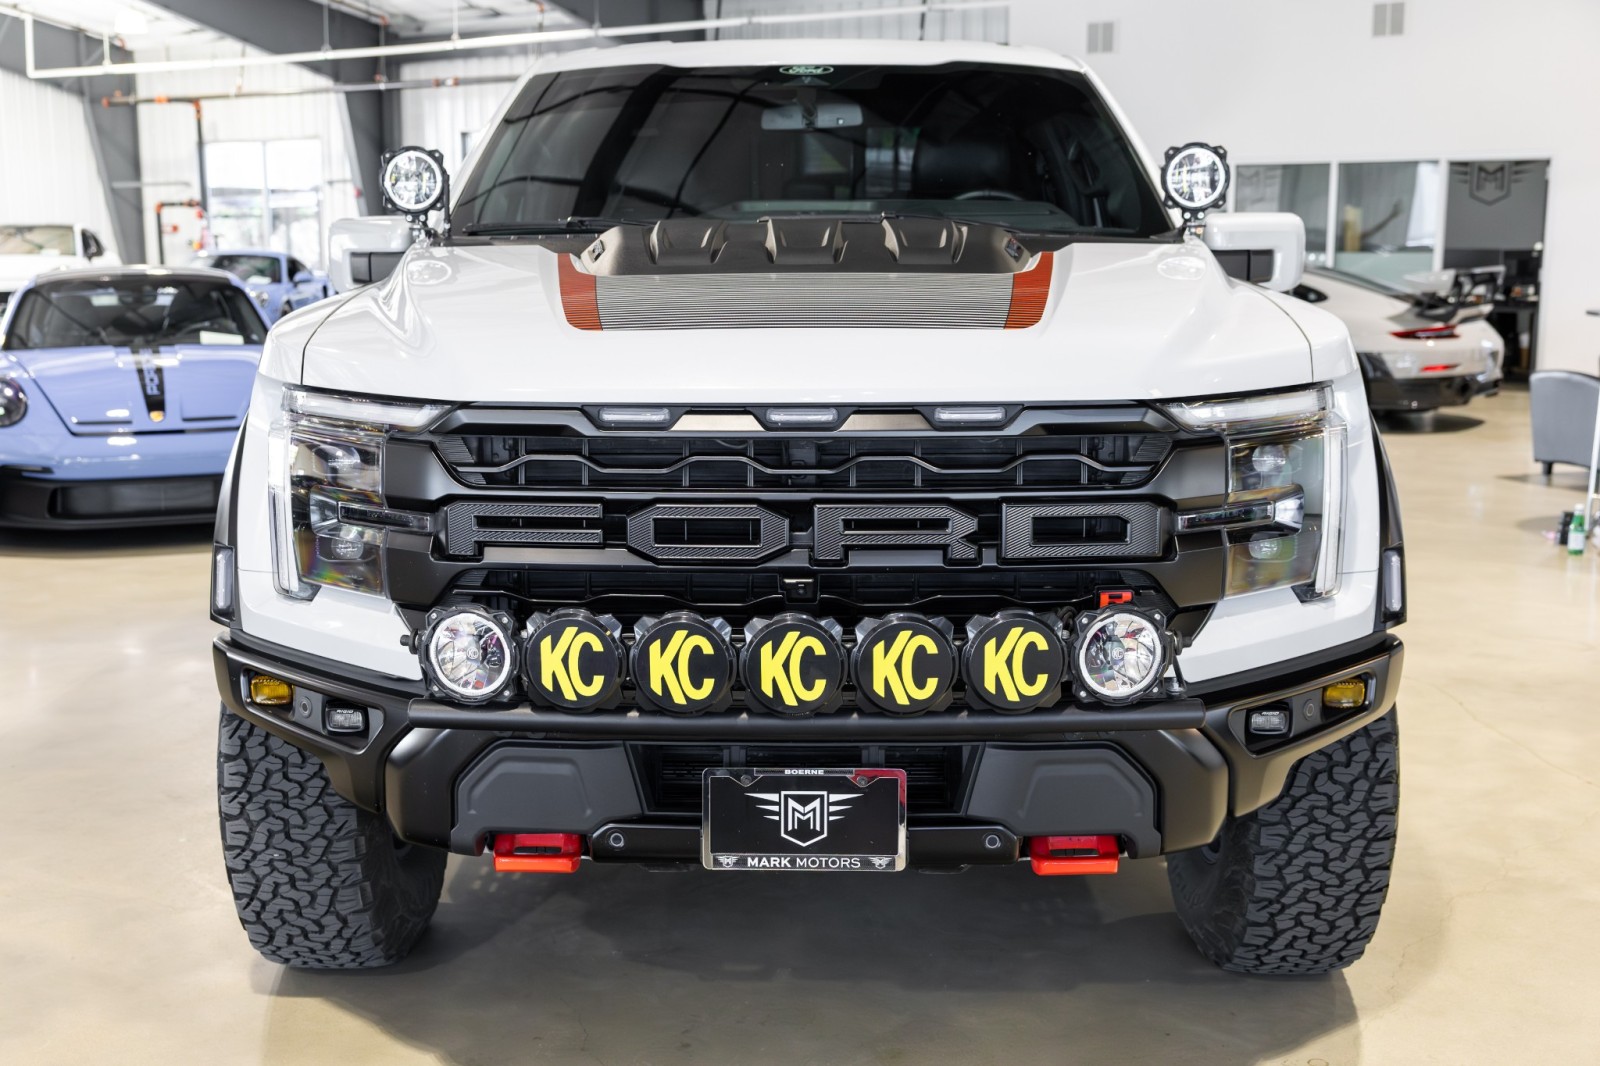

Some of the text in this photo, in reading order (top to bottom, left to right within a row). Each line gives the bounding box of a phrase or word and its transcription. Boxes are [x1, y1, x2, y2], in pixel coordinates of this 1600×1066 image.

[446, 501, 1167, 564] FORD
[540, 627, 604, 701] KC
[649, 629, 715, 705] KC
[761, 631, 826, 707] KC
[872, 630, 939, 706] KC
[983, 626, 1049, 702] KC
[747, 857, 861, 868] MARK MOTORS
